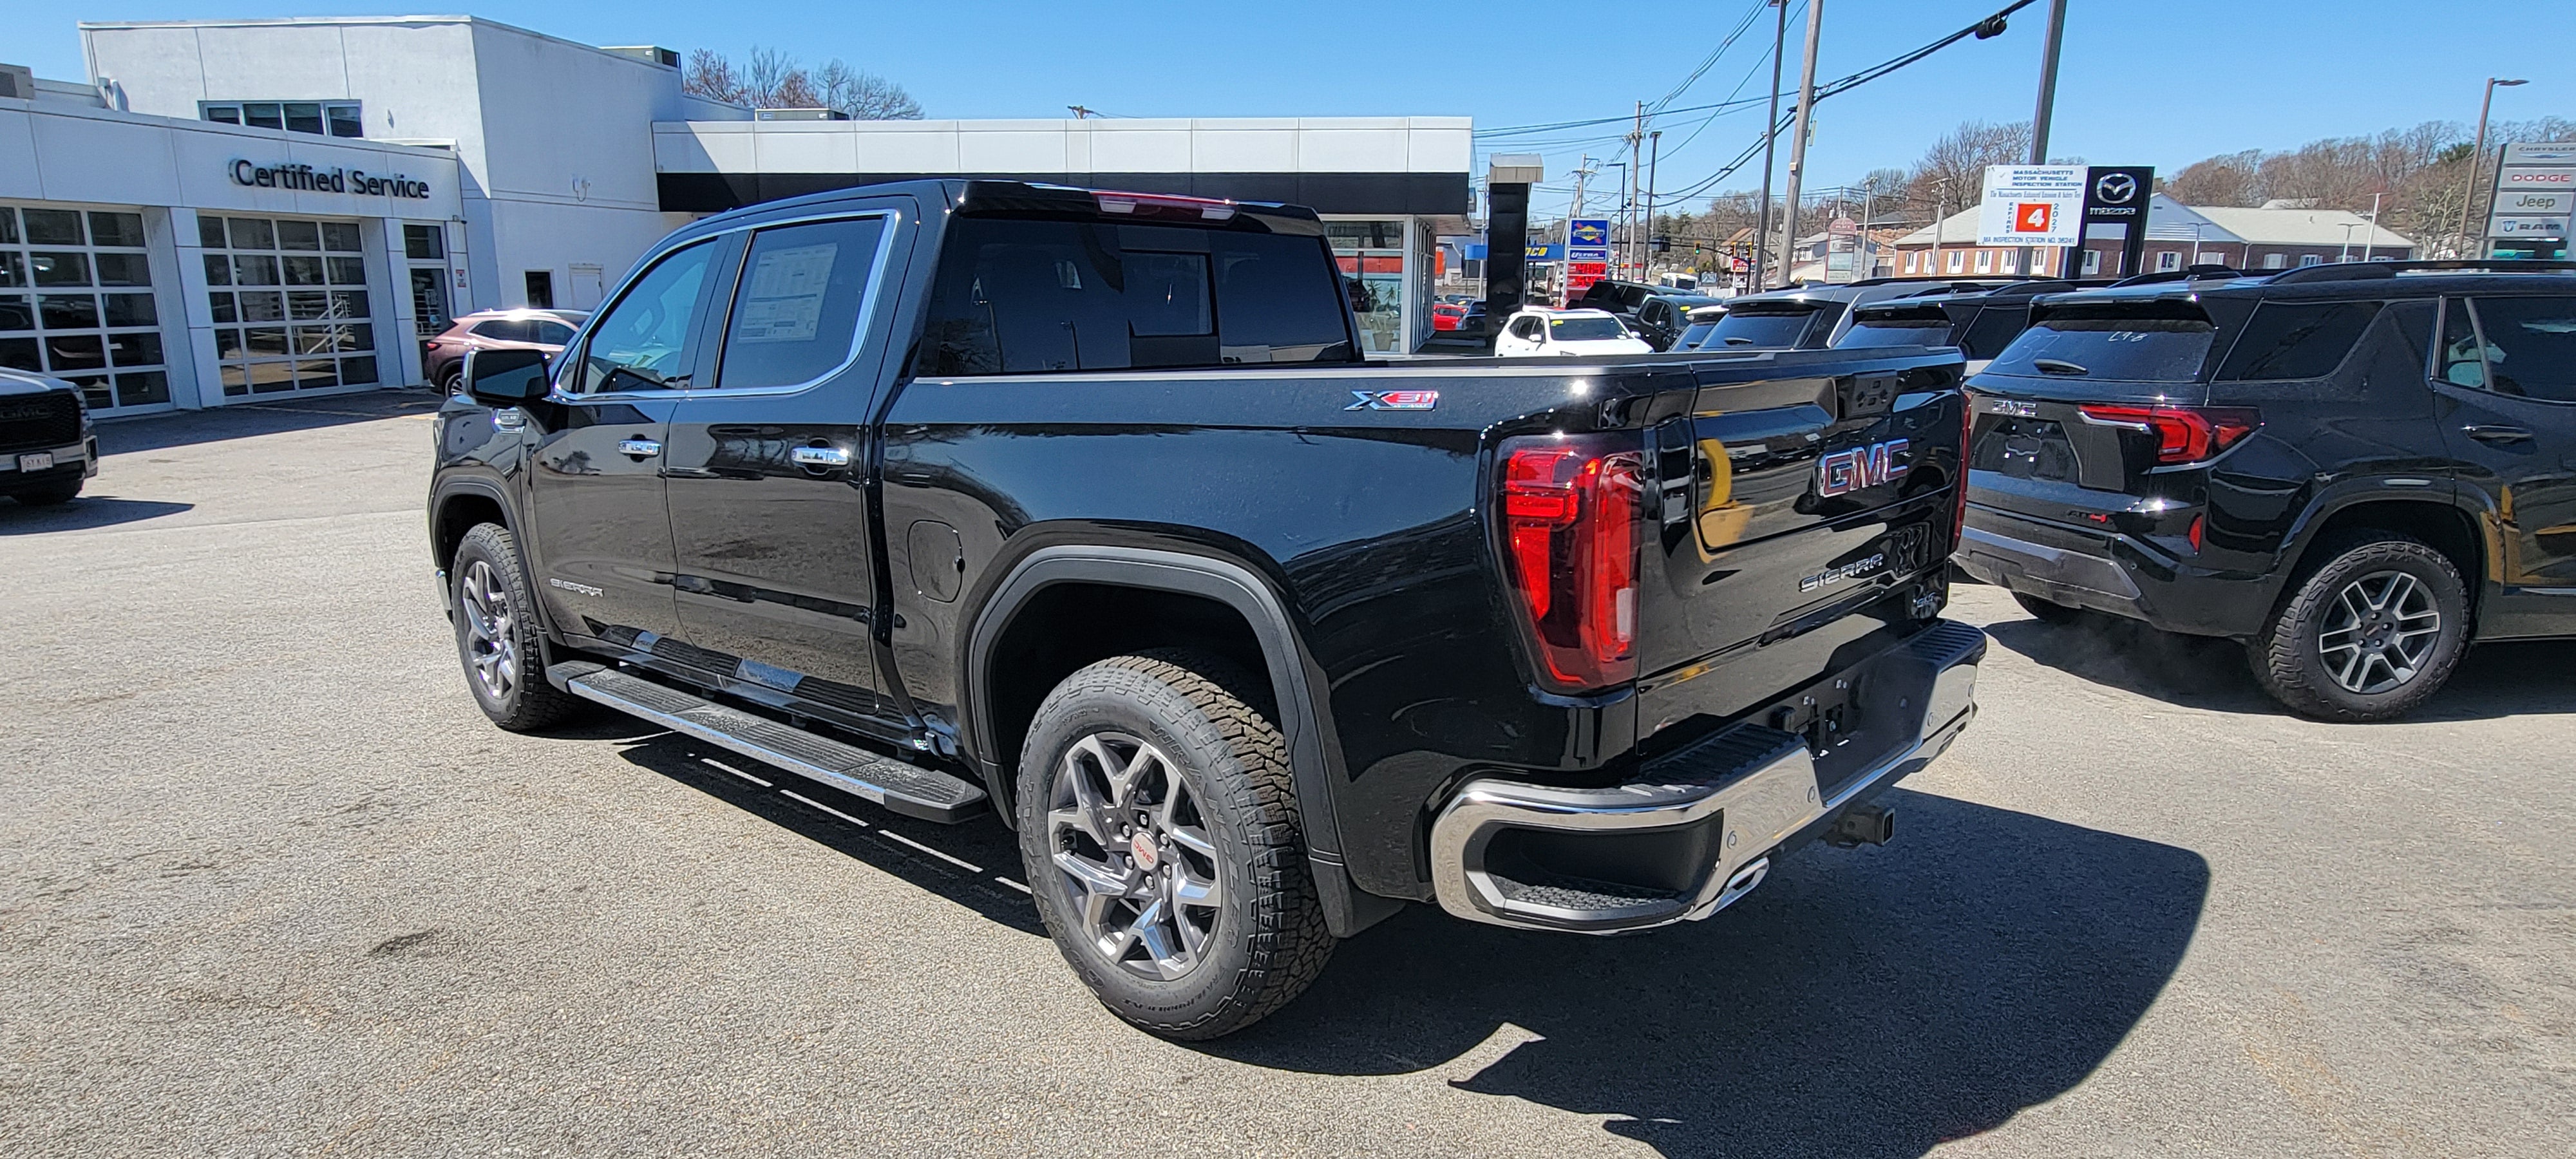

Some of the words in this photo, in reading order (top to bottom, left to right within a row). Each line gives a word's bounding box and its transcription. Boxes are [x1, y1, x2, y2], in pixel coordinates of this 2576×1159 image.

[230, 159, 345, 193] Certified
[348, 169, 430, 199] Service
[2516, 195, 2555, 209] Jeep
[2028, 208, 2045, 227] 4
[1992, 400, 2037, 417] GMC
[1817, 438, 1909, 498] GMC
[1799, 553, 1883, 593] SIERRA
[550, 578, 604, 598] SIERRA
[1133, 839, 1154, 864] GMC
